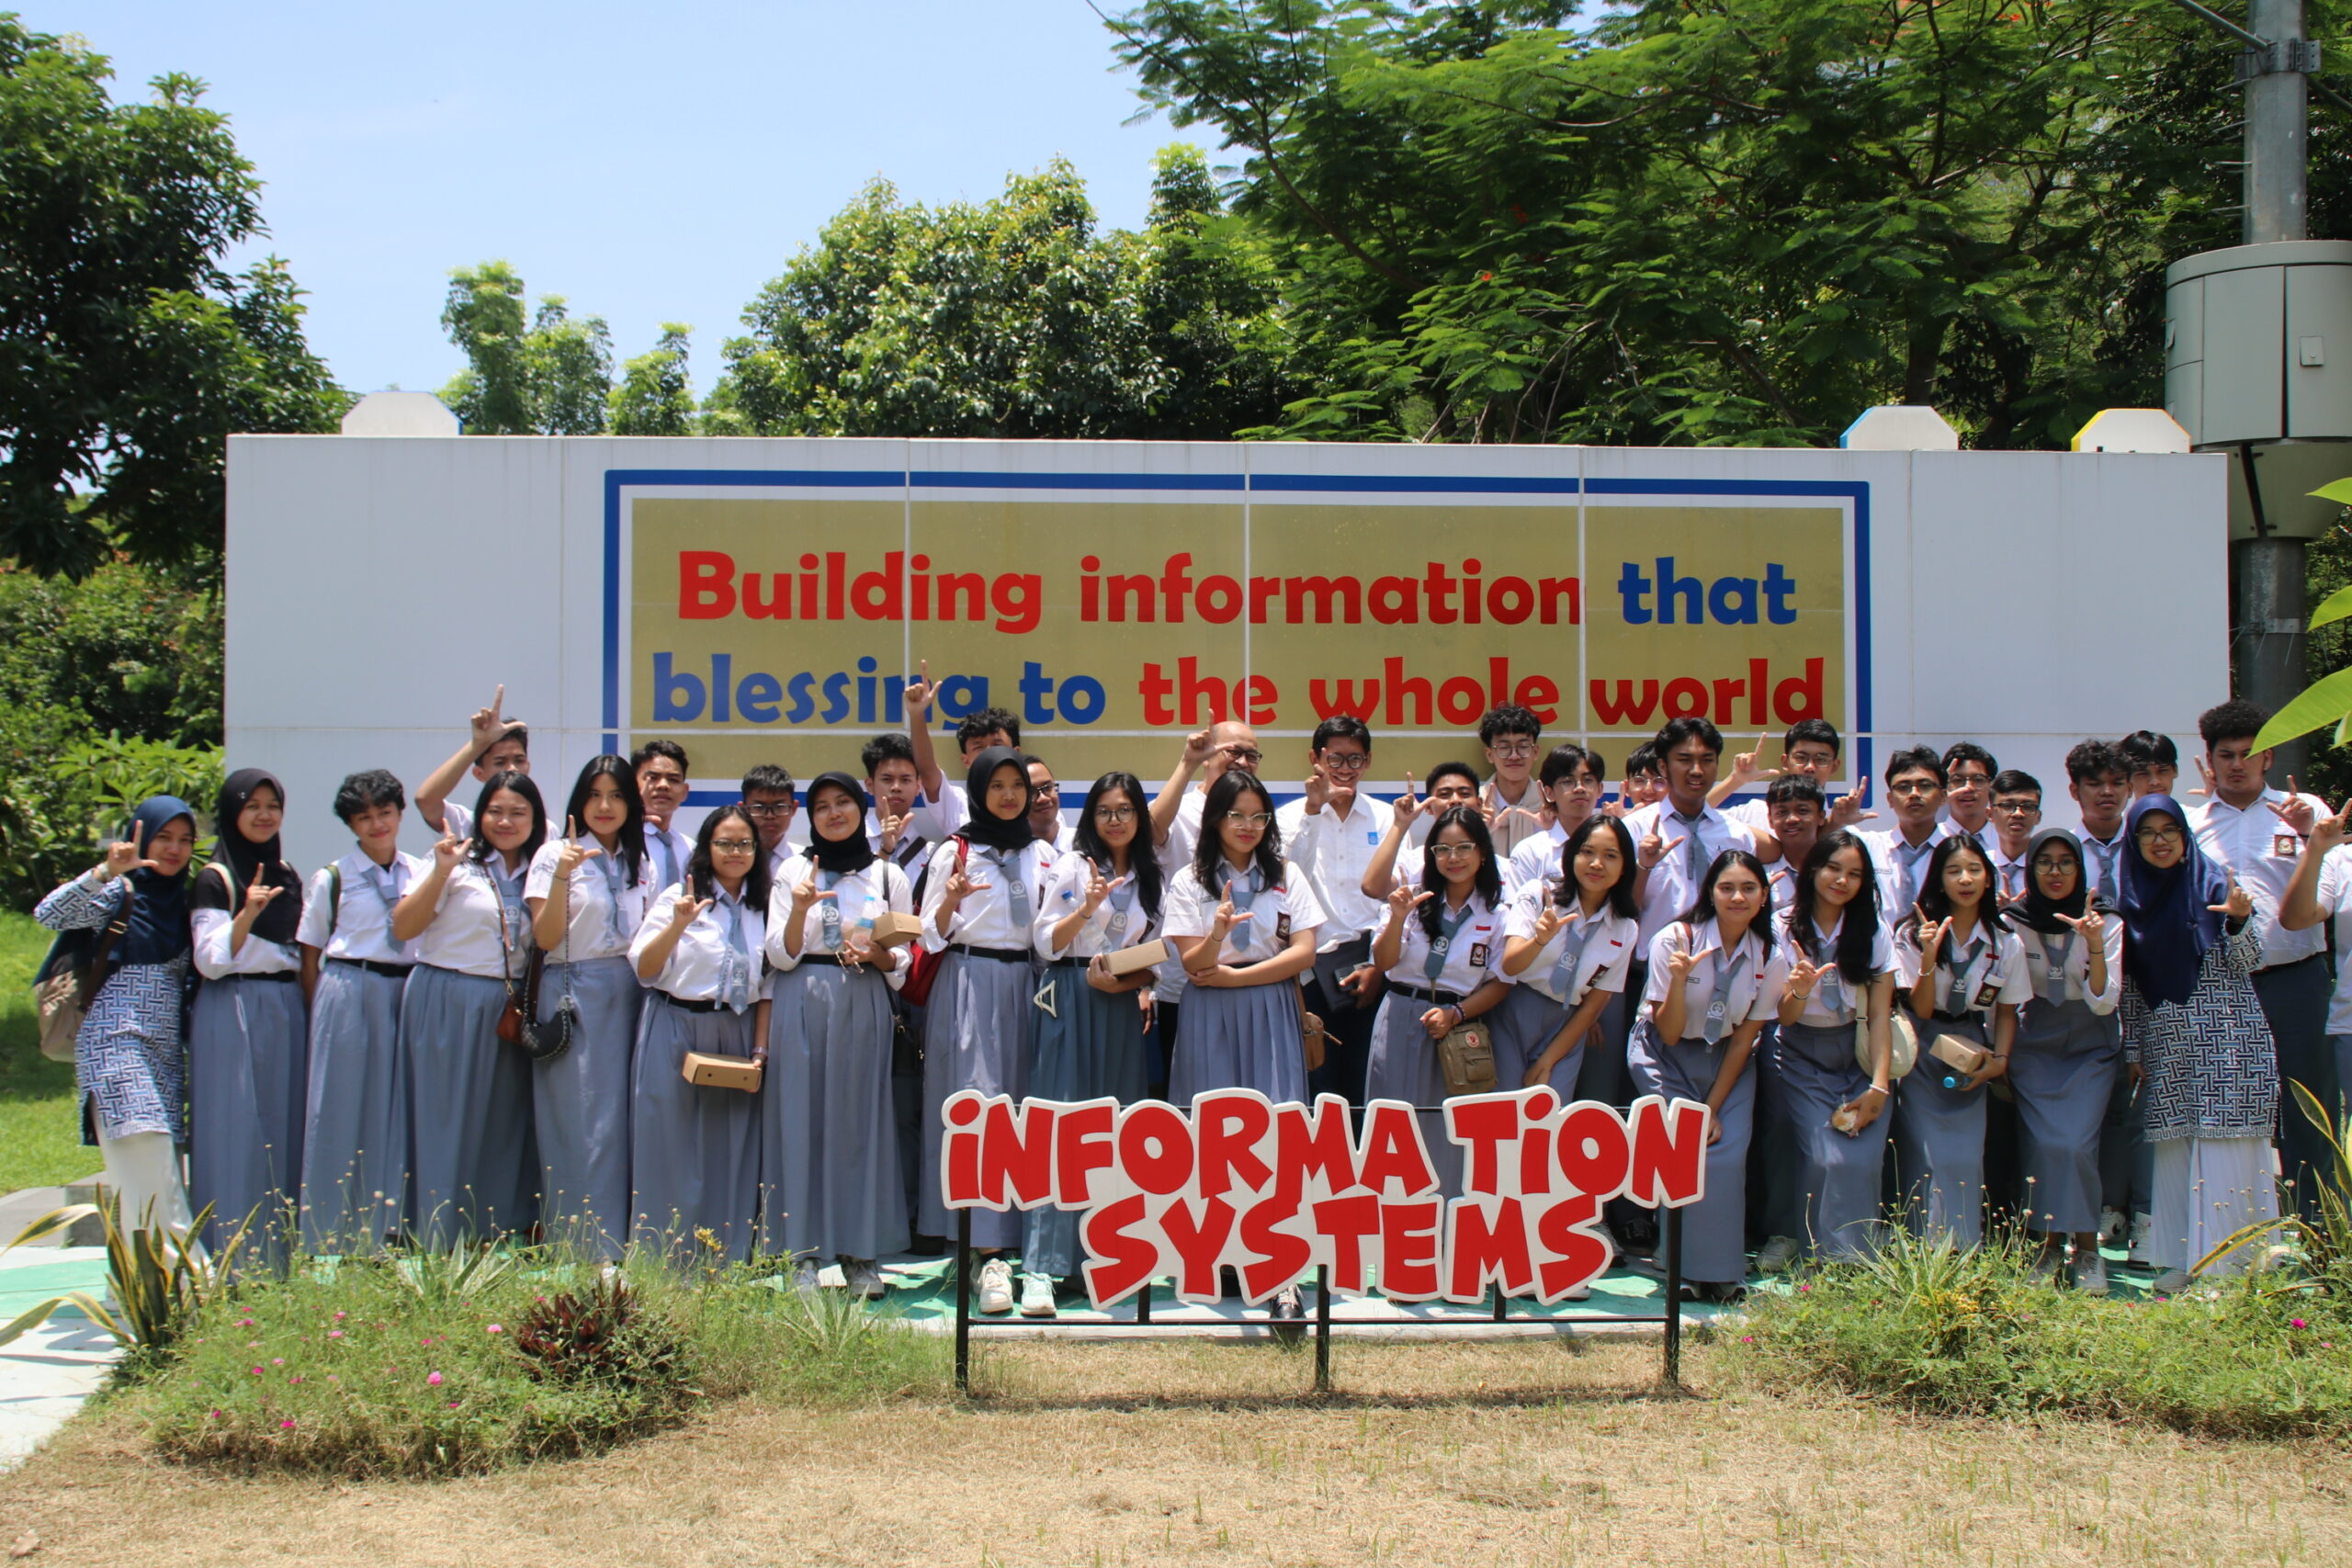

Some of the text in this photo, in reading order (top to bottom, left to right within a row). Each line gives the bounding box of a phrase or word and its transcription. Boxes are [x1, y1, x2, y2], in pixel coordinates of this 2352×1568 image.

[678, 551, 1797, 635] Building information that
[653, 652, 1825, 731] blessing to the whole world
[1086, 1193, 1614, 1304] SYSTEMS
